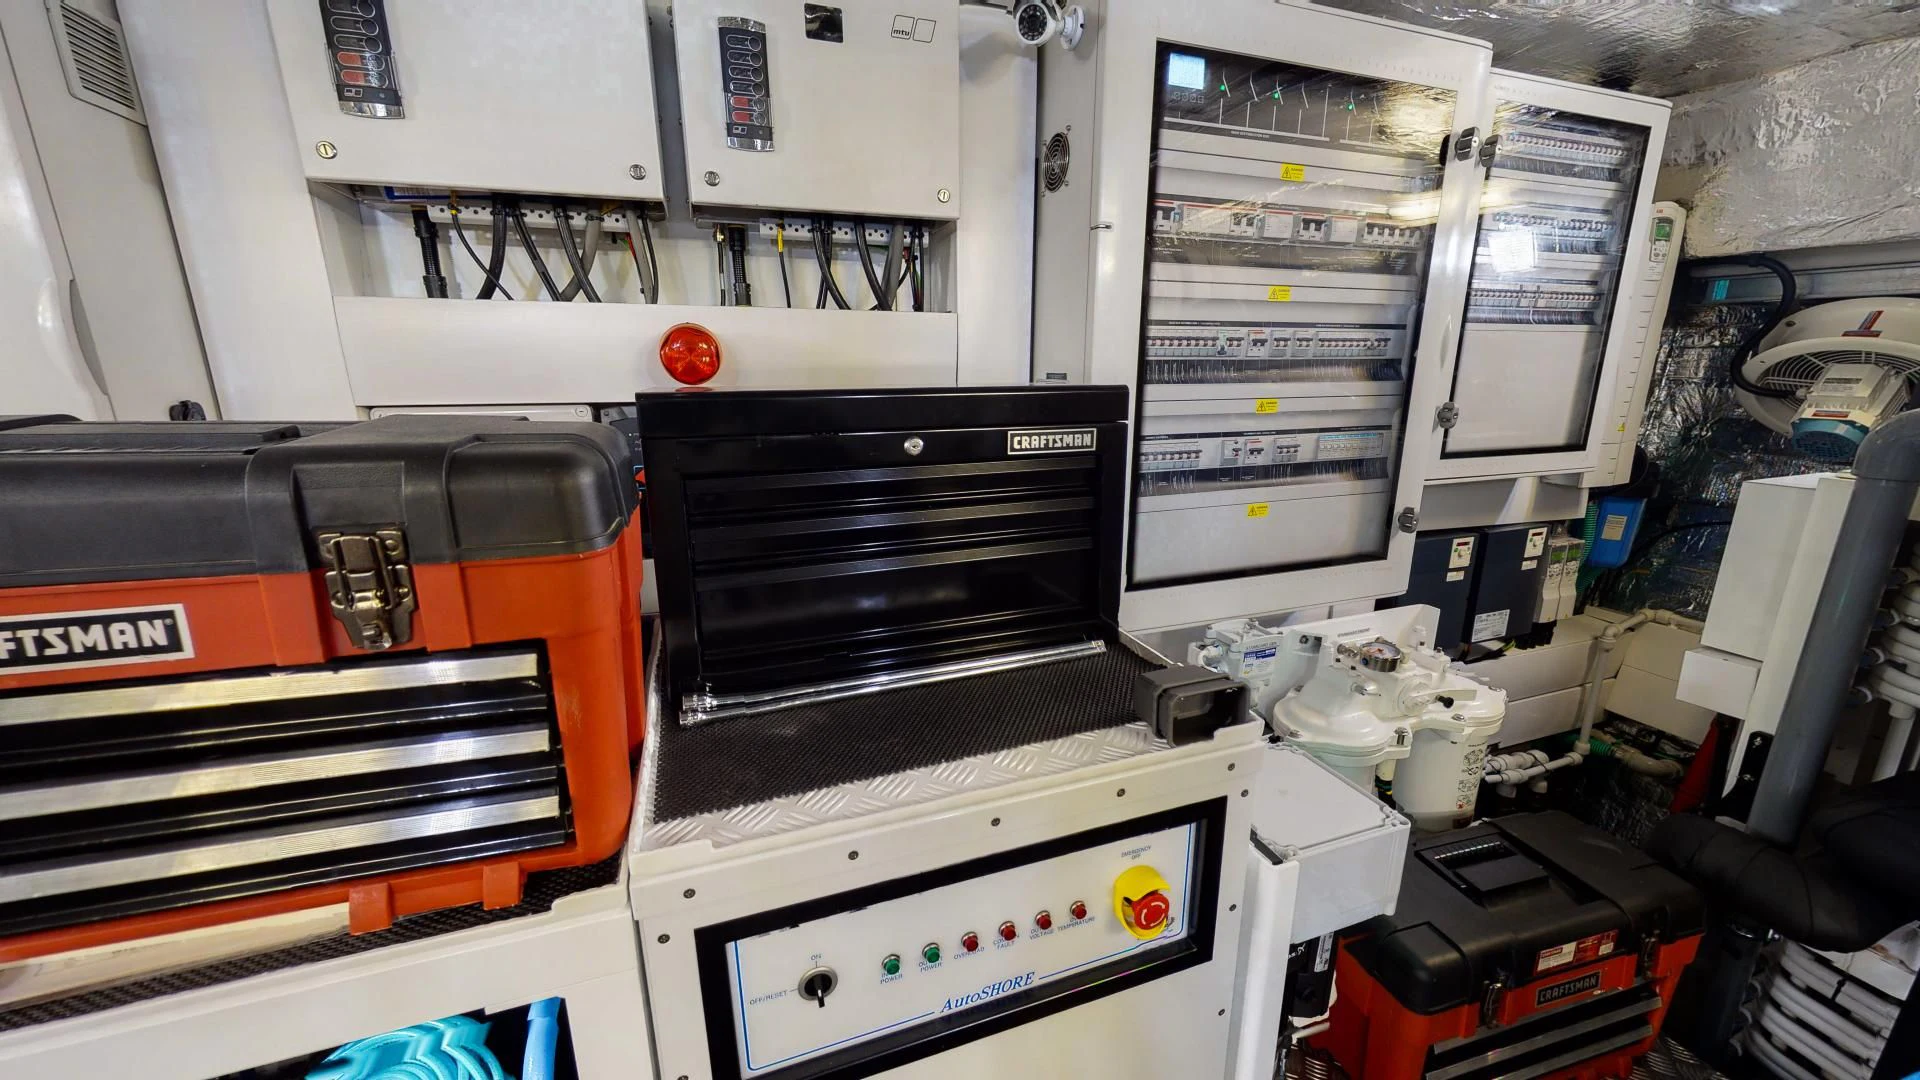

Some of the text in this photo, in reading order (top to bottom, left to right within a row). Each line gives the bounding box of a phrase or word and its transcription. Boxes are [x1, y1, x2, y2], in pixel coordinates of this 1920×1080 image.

[1013, 433, 1092, 449] CRAFTSMAN
[1030, 929, 1054, 940] VOLTAGE
[811, 953, 822, 961] ON
[920, 962, 942, 972] POWER
[880, 974, 903, 984] POWER
[939, 971, 1035, 1014] AutoSHORE
[1540, 975, 1597, 1001] CRAFTSMAN
[749, 990, 788, 1005] OFF/RESET
